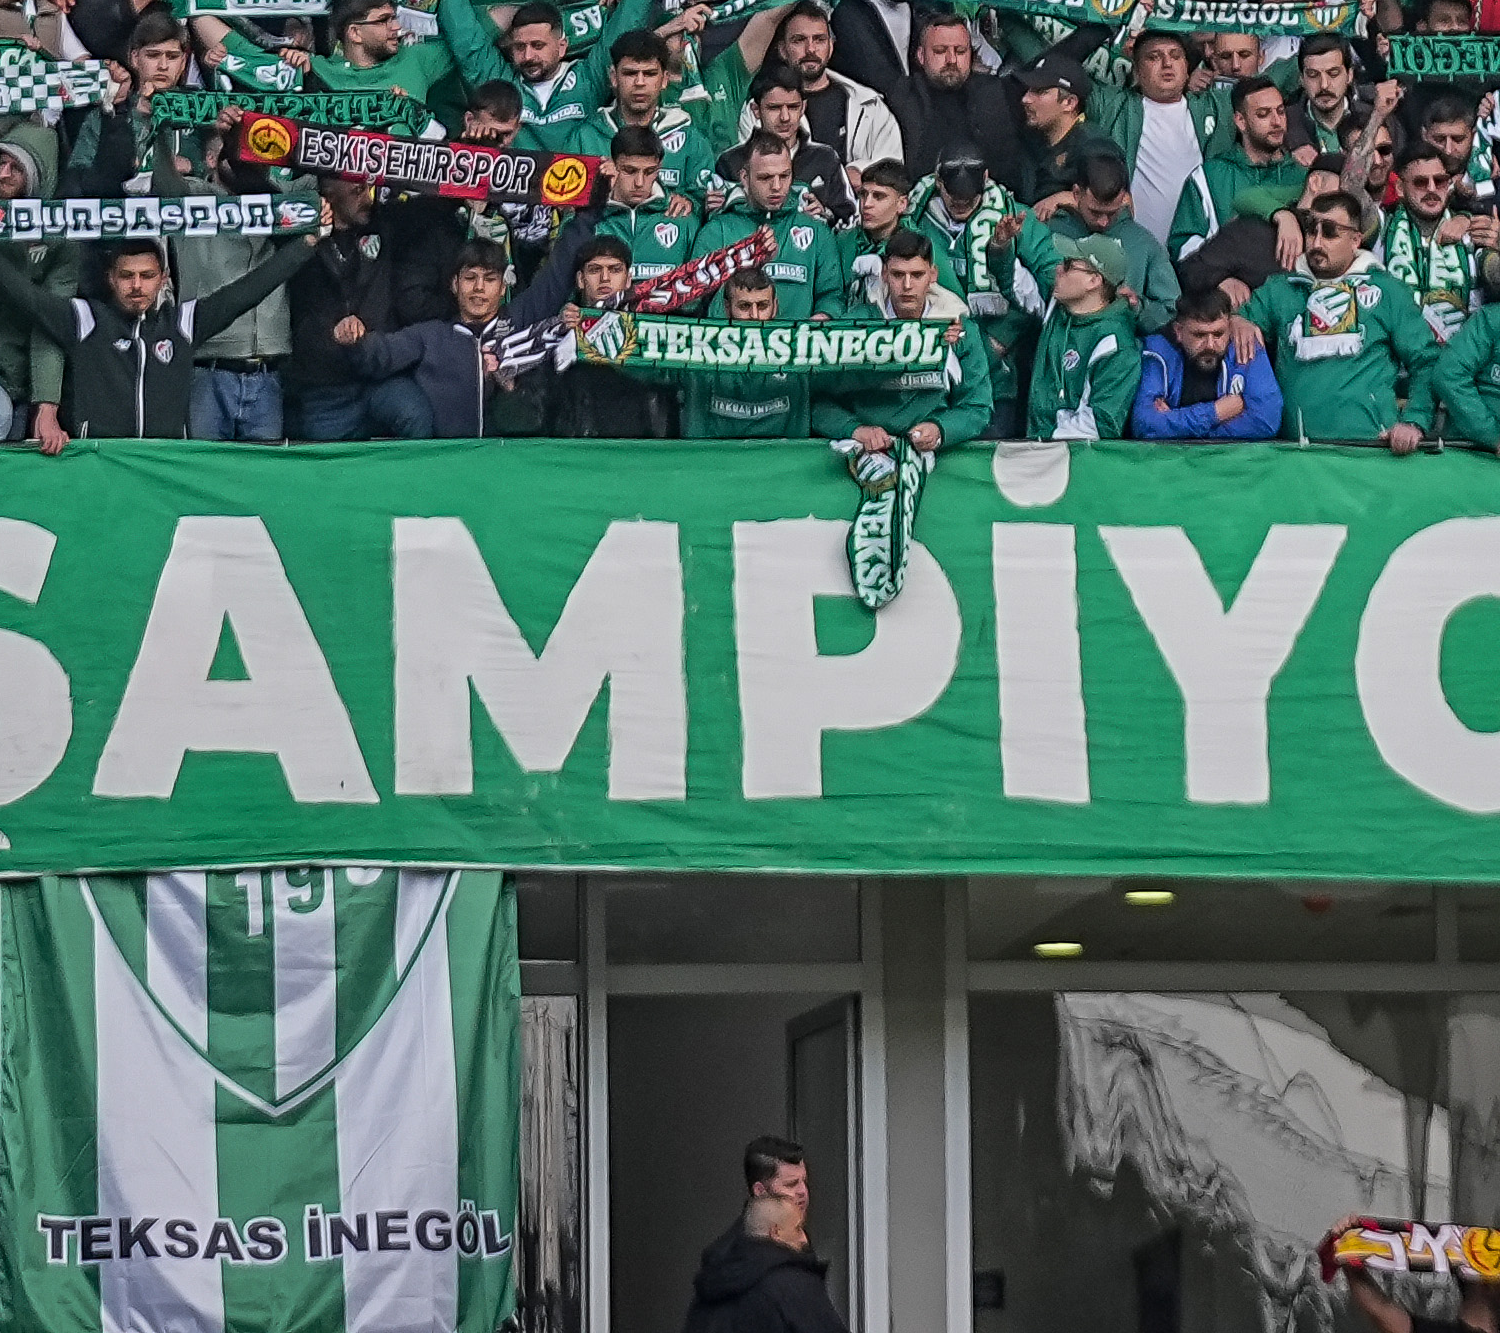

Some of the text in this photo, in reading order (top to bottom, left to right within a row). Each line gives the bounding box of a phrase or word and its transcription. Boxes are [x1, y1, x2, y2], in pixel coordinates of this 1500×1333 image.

[299, 128, 535, 195] ESKİŞEHİRSPOR
[12, 199, 276, 241] BURSASPOR
[636, 319, 947, 366] TEKSASİNEGÖL
[36, 1203, 508, 1268] TEKSAS İNEGÖL
